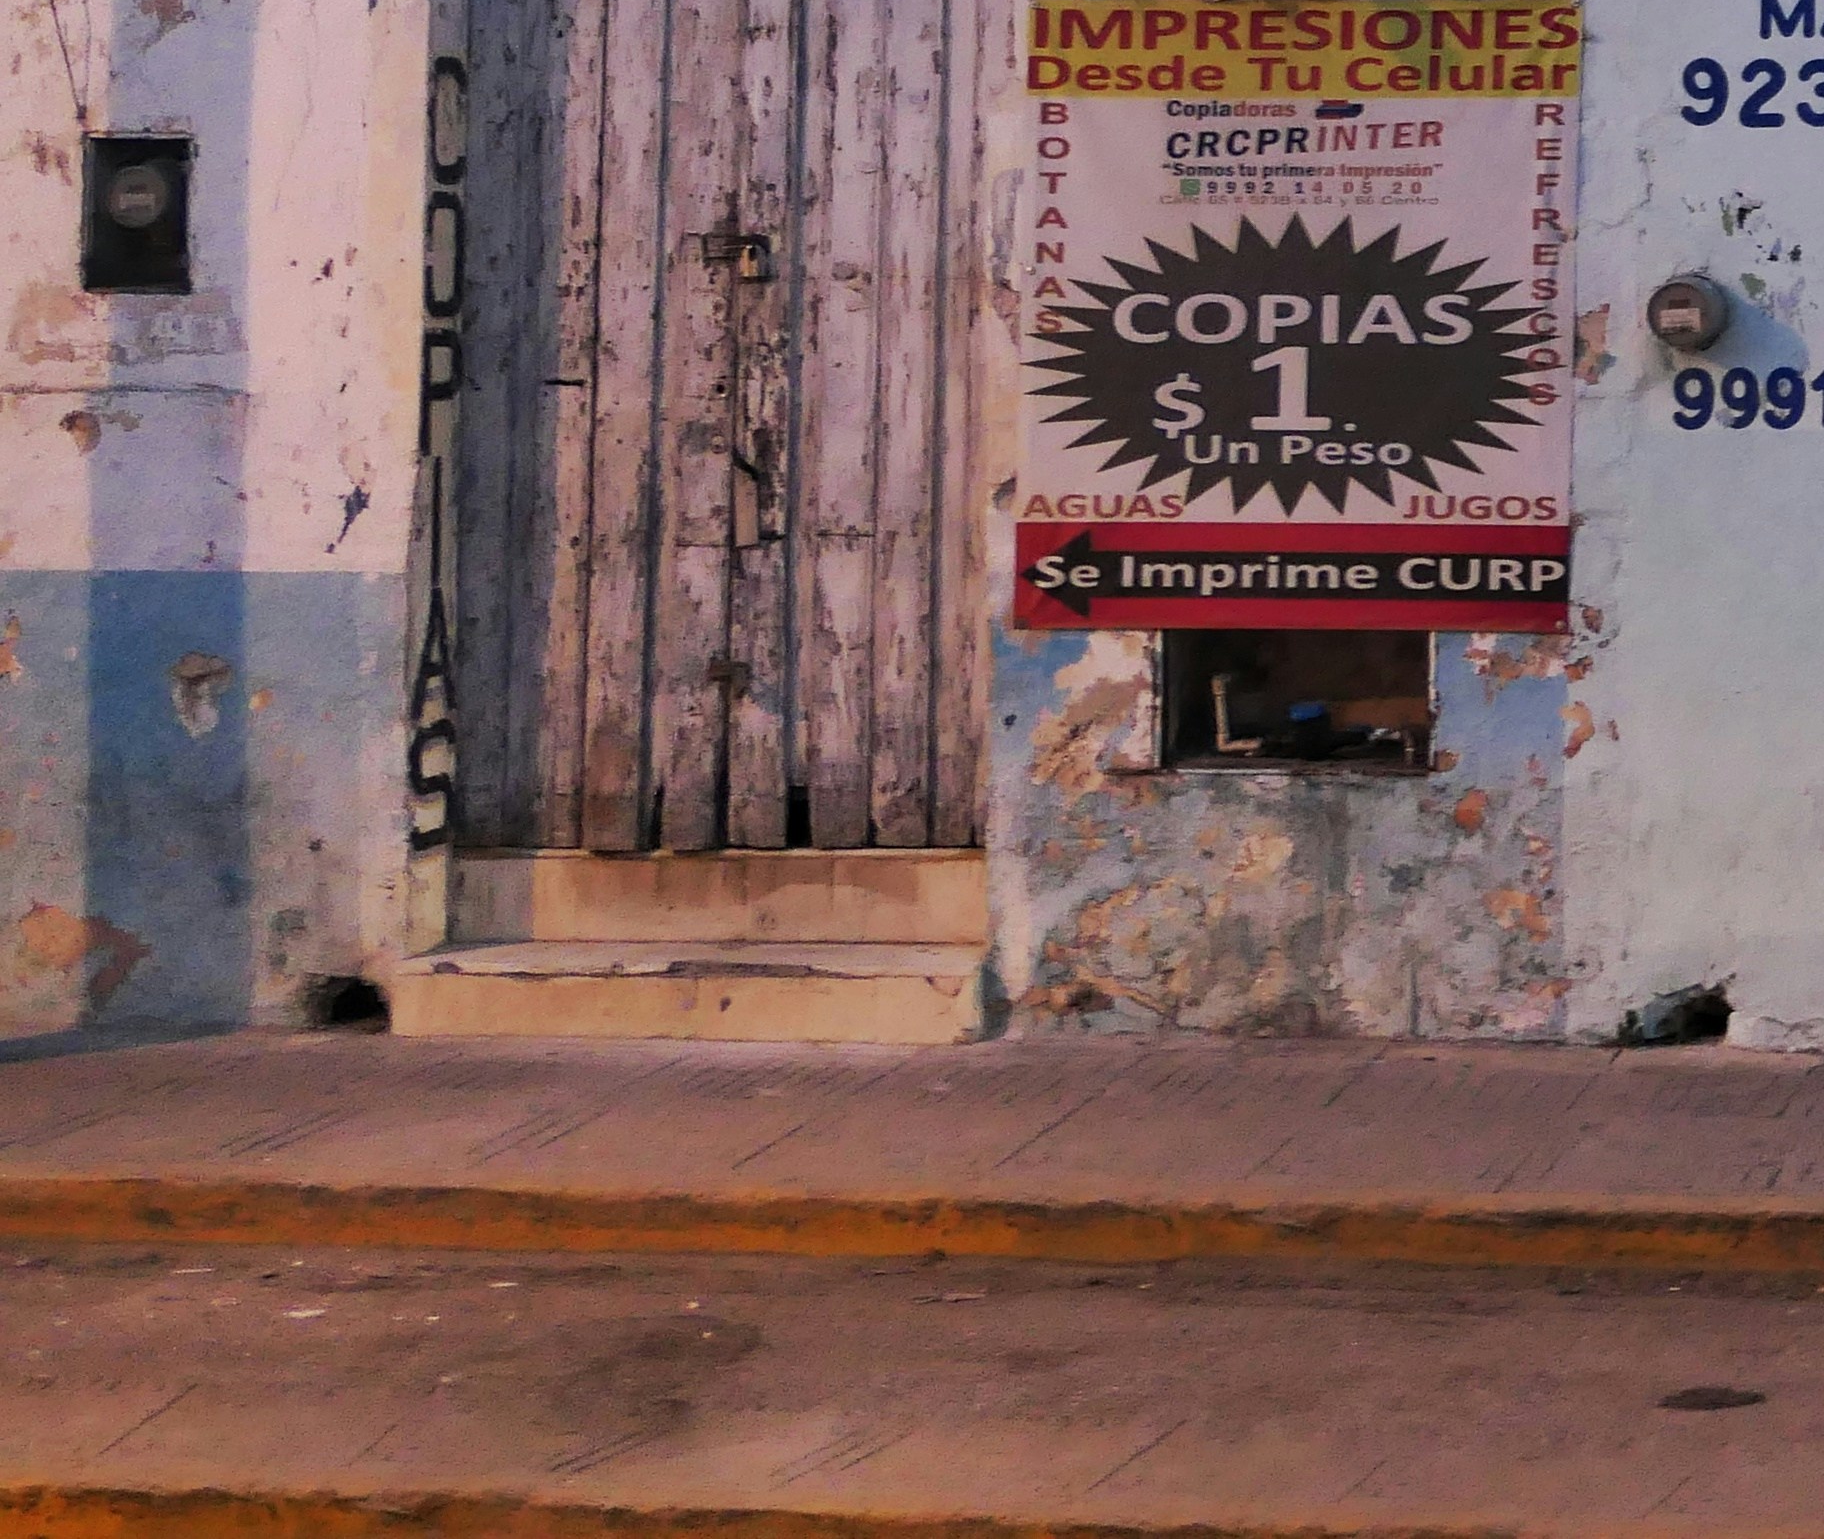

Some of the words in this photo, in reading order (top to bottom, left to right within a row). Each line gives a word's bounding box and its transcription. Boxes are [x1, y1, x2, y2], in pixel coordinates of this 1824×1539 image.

[1033, 6, 1580, 54] IMPRESIONES
[1026, 54, 1227, 94] Desde
[1247, 56, 1322, 94] Tu
[1345, 54, 1577, 93] Celular
[1166, 100, 1298, 120] Copiadoras
[1166, 120, 1445, 159] CRCPRINTER
[1238, 164, 1258, 177] tu
[1263, 164, 1335, 179] primera
[1034, 102, 1069, 335] BOTANAS
[1526, 102, 1566, 407] REFRESCOS
[1111, 291, 1475, 347] COPIAS
[1153, 371, 1205, 439] $
[1182, 434, 1261, 466] Un
[1279, 433, 1414, 467] Peso
[1022, 492, 1185, 521] AGUAS
[1401, 493, 1558, 521] JUGOS
[1033, 554, 1100, 591] Se
[1120, 556, 1378, 600] Imprime
[1398, 556, 1567, 592] CURP
